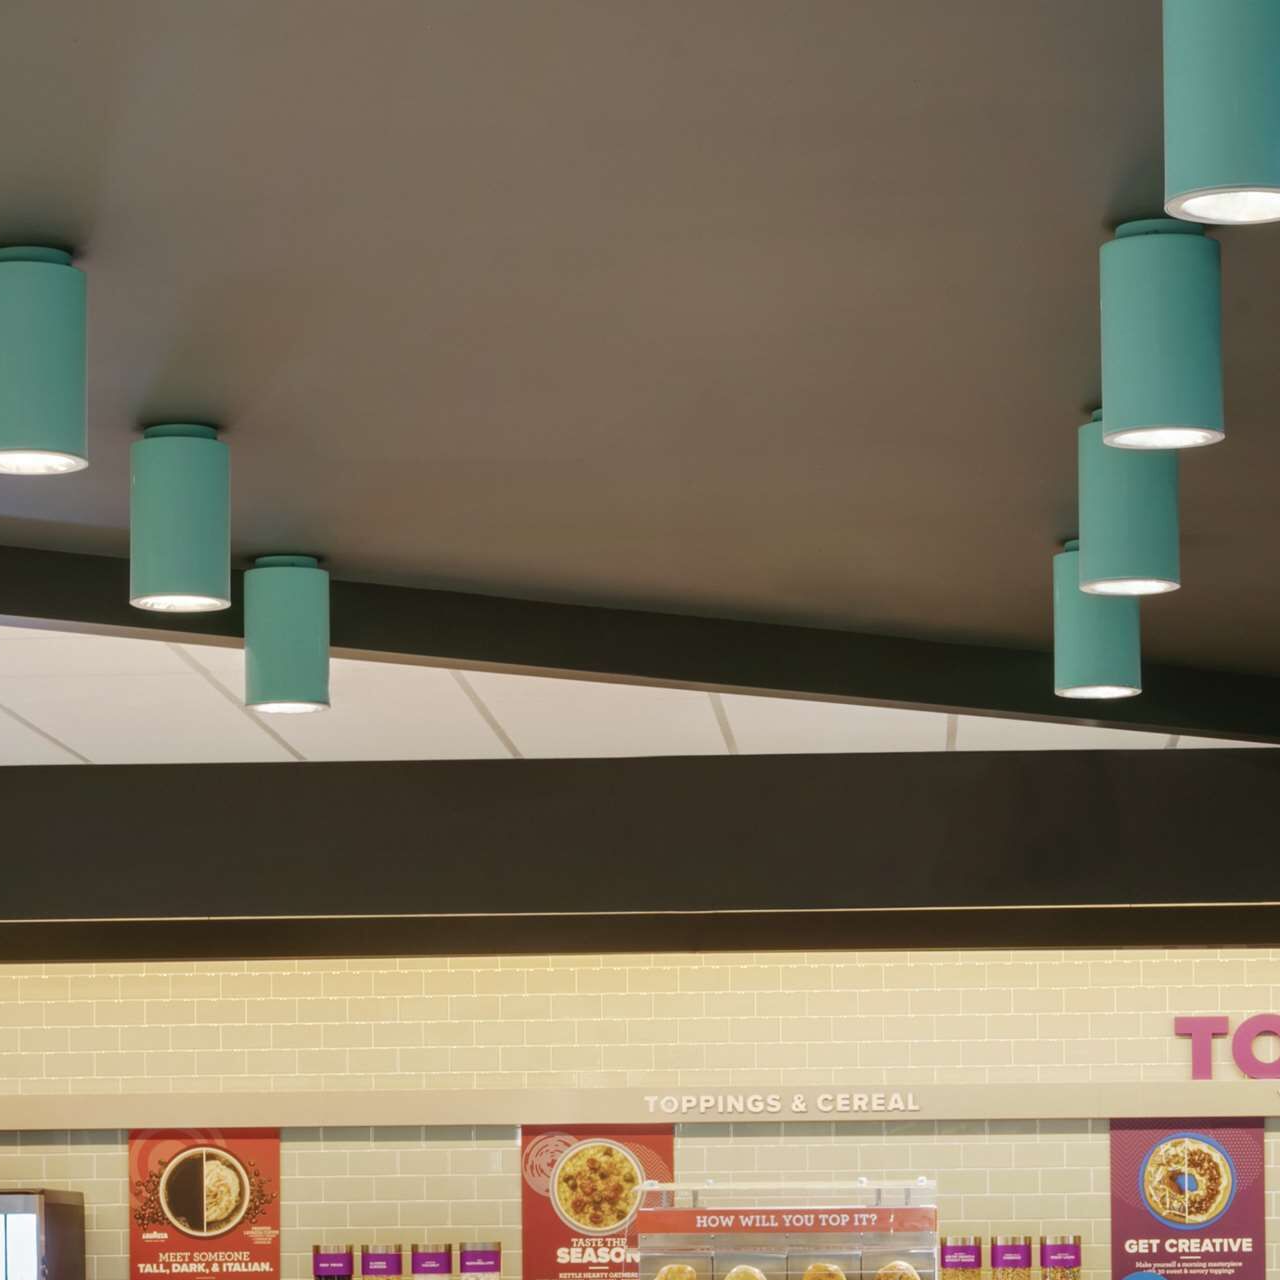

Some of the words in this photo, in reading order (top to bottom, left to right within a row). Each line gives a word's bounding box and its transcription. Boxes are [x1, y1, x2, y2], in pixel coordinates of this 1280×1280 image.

[644, 1093, 782, 1113] TOPPINGS
[791, 1094, 808, 1112] &
[817, 1092, 921, 1112] CEREAL
[696, 1215, 734, 1228] HOW
[739, 1214, 778, 1227] WILL
[783, 1214, 814, 1227] YOU
[818, 1213, 850, 1226] TOP
[853, 1213, 878, 1226] IT?
[570, 1237, 604, 1247] TASTE
[605, 1237, 627, 1247] THE
[1124, 1238, 1160, 1253] GET
[1164, 1237, 1253, 1253] CREATIVE
[159, 1251, 191, 1263] MEET
[193, 1251, 250, 1262] SOMEONE
[556, 1246, 640, 1264] SEASON
[138, 1263, 170, 1274] TALL,
[172, 1263, 209, 1274] DARK,
[211, 1263, 219, 1273] &
[223, 1262, 273, 1273] ITALIAN.
